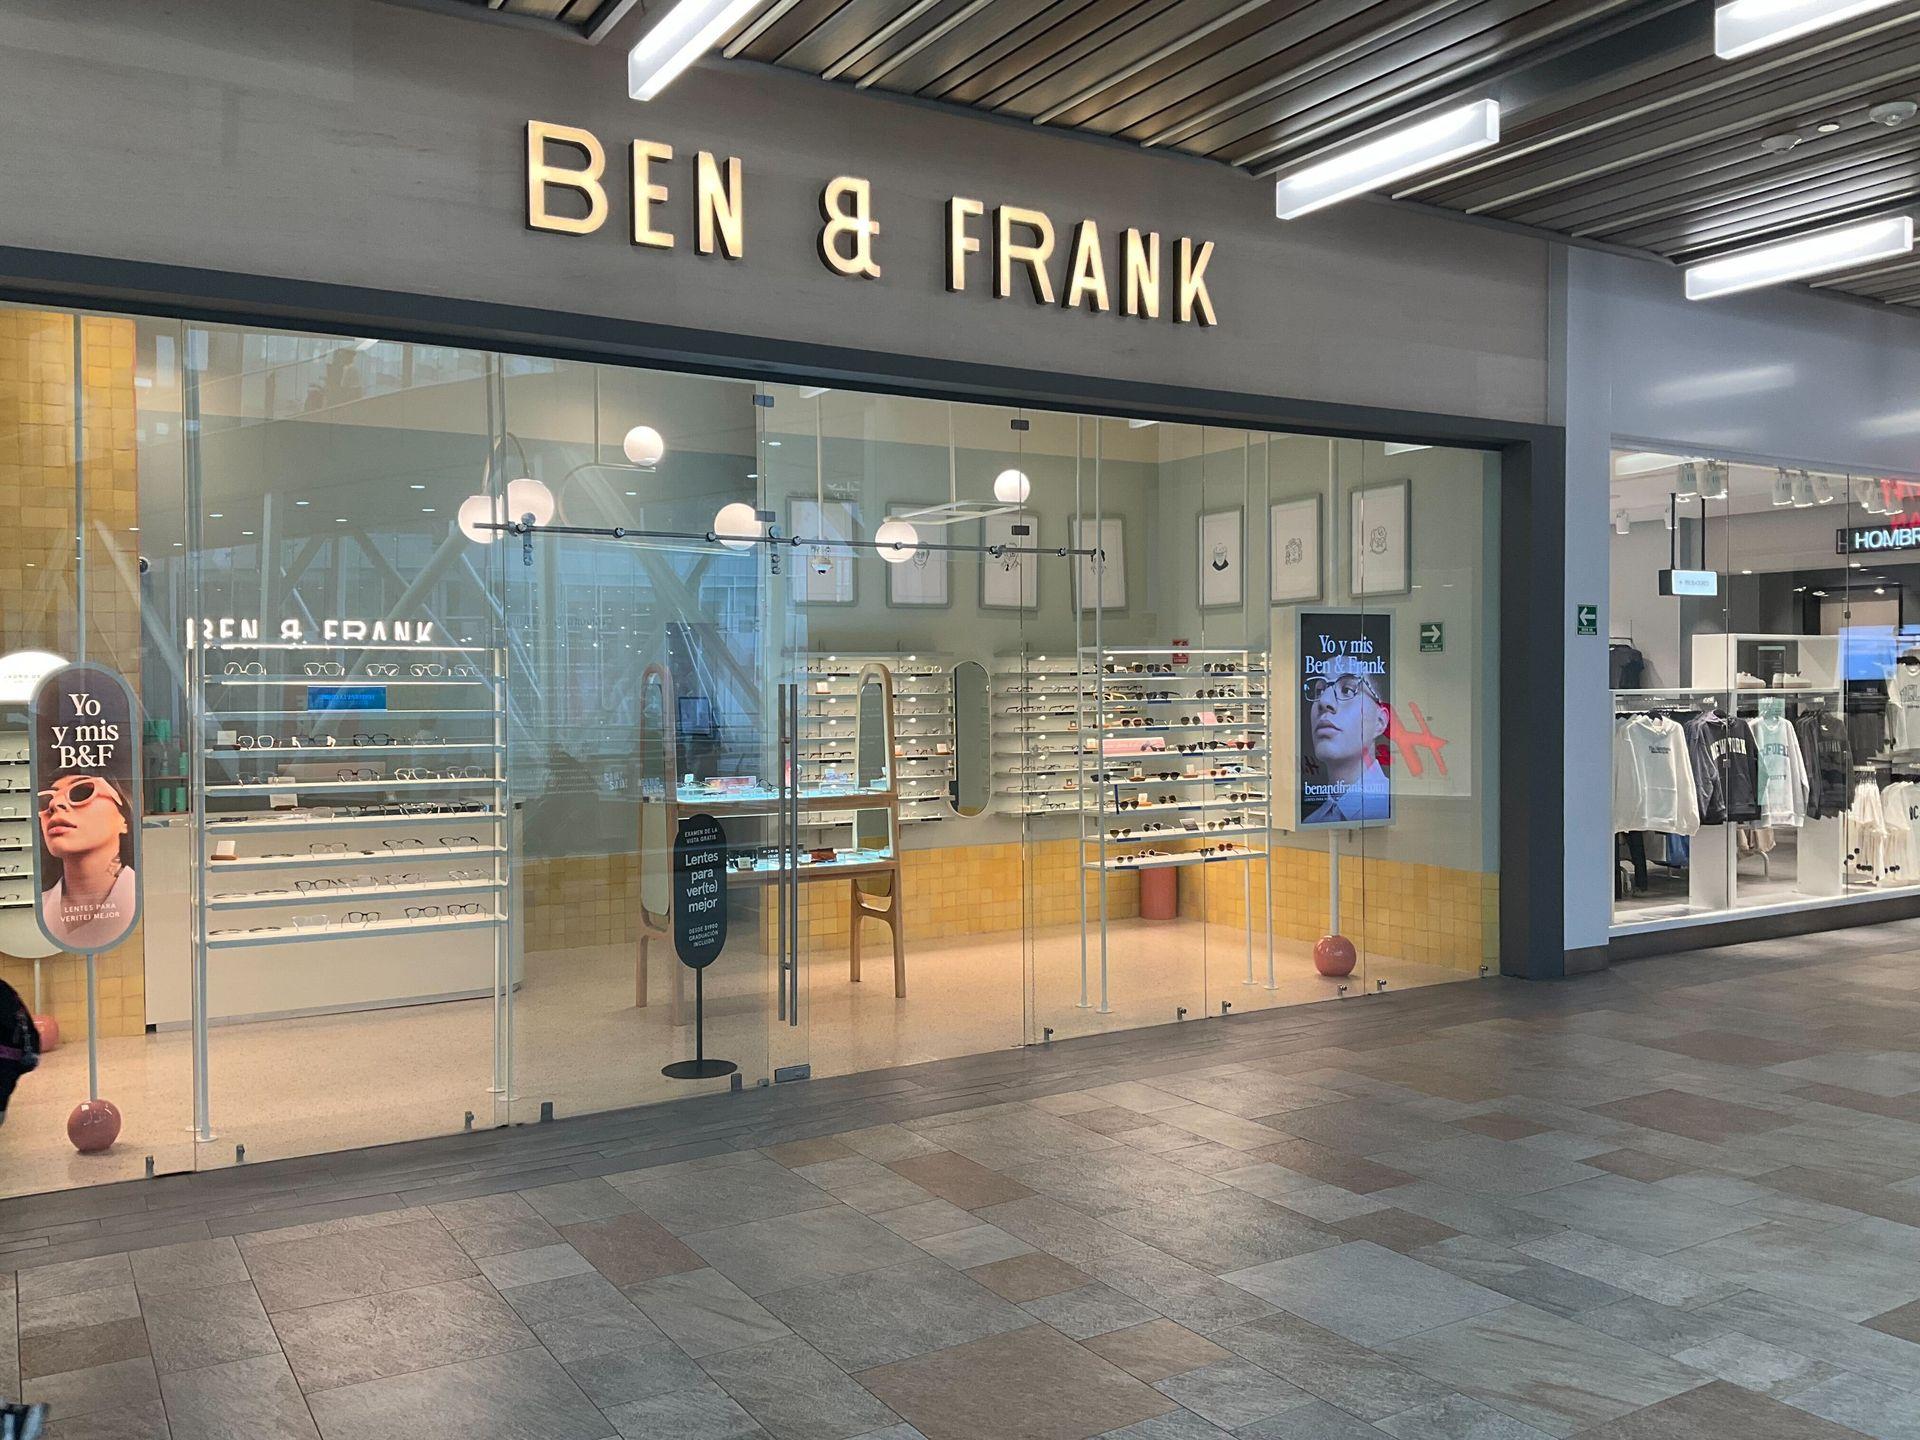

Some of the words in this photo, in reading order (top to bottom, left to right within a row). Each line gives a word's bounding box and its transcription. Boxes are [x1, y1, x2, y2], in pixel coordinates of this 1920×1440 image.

[526, 119, 743, 259] BEN
[819, 176, 881, 280] &
[946, 196, 1218, 326] FRANK
[1318, 635, 1335, 653] Yo
[1337, 640, 1347, 657] y
[1350, 636, 1373, 653] mis
[1304, 655, 1331, 674] Ben
[1335, 656, 1347, 674] &
[1349, 656, 1385, 674] Frank
[68, 693, 101, 716] Yo
[51, 727, 69, 749] y
[75, 720, 119, 743] mis
[58, 743, 115, 769] B&F
[685, 851, 719, 867] Lentes
[691, 869, 714, 884] para
[686, 880, 718, 898] ver(te)
[64, 904, 94, 913] LENTES
[688, 897, 718, 913] mejor
[93, 911, 120, 919] MEJOR
